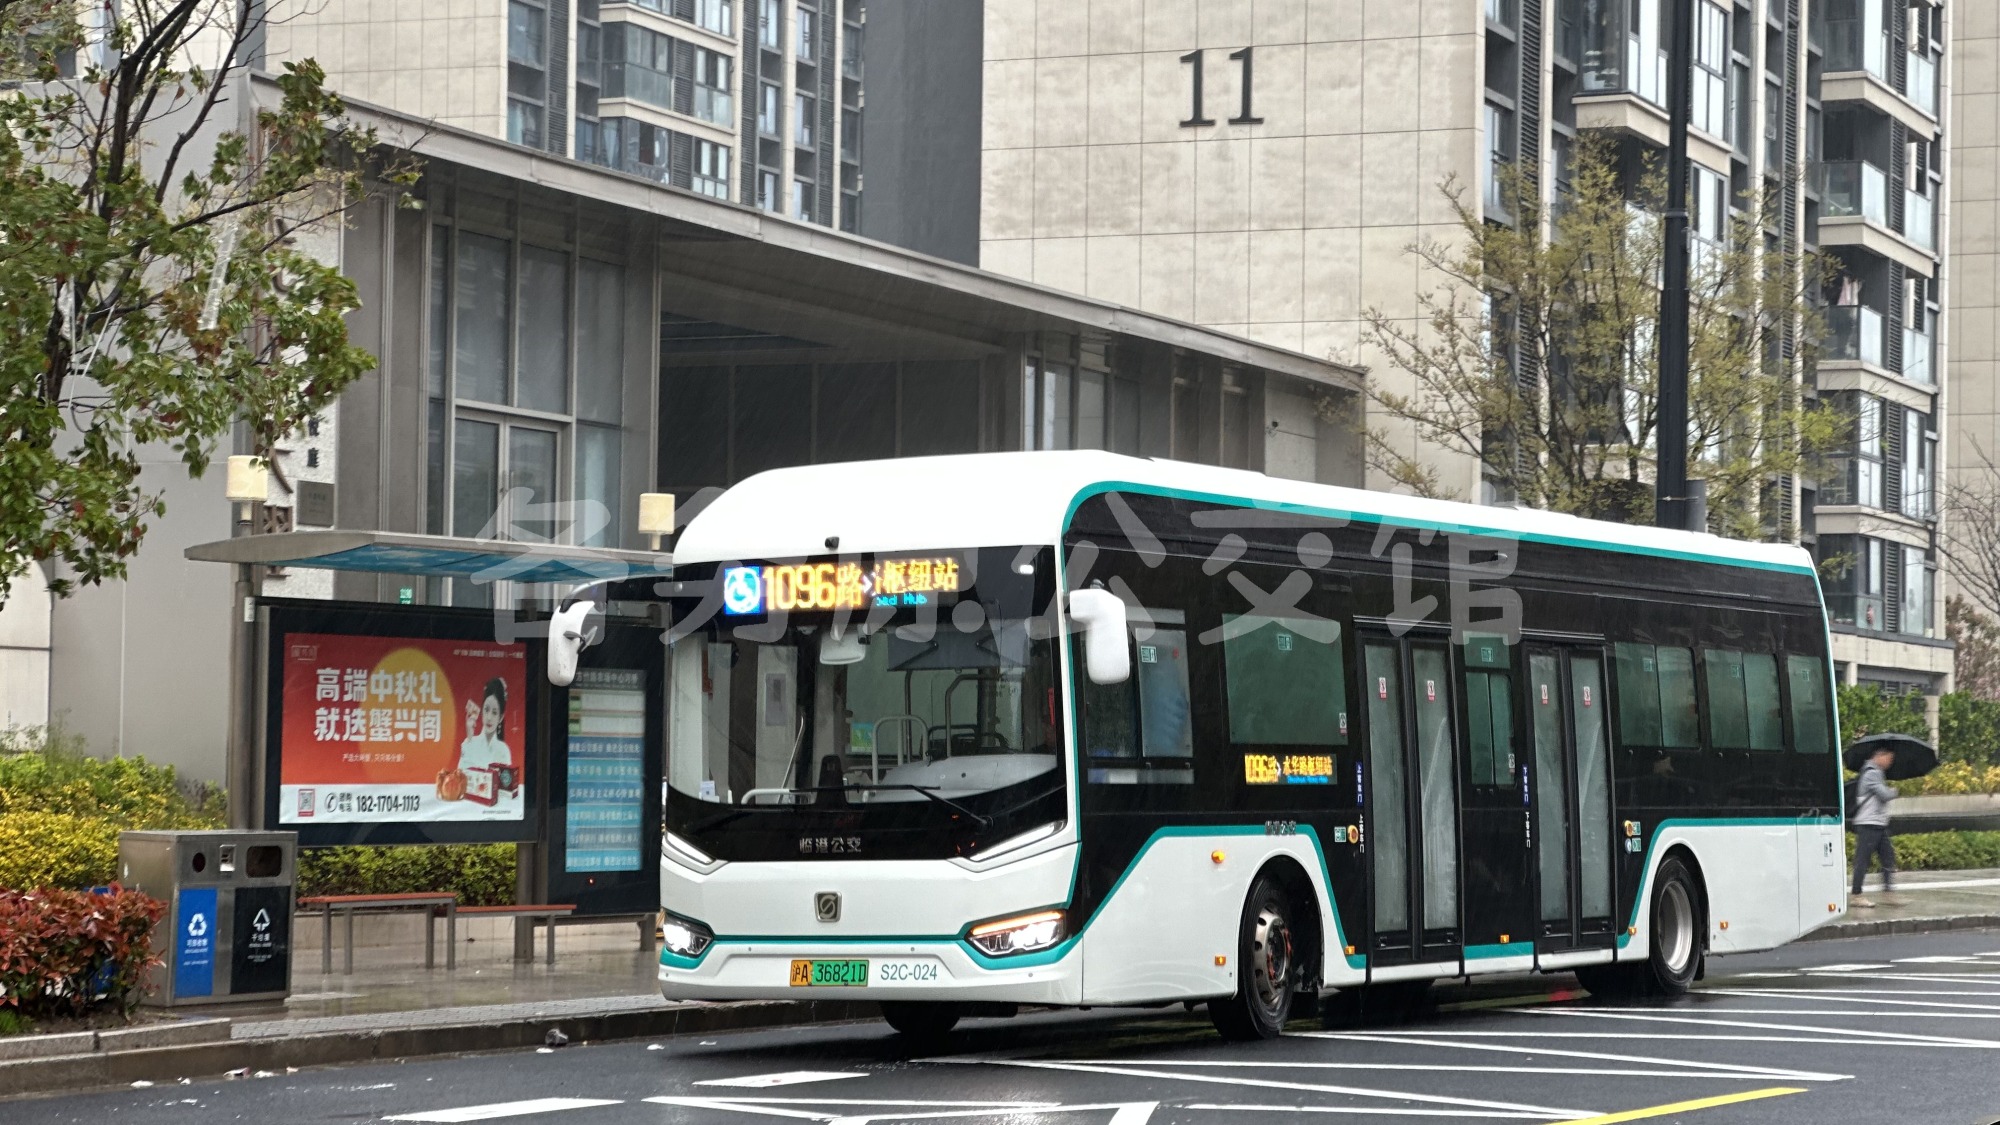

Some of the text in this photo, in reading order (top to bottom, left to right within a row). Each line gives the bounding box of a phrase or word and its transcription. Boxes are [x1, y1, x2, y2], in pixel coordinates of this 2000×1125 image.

[1180, 47, 1264, 127] 11
[762, 557, 959, 611] 1096路 枢纽站
[316, 667, 442, 704] 高端中秋礼
[357, 795, 420, 813] 182-1704-1113
[800, 837, 861, 853] 临港公交
[880, 964, 938, 981] S2C-024
